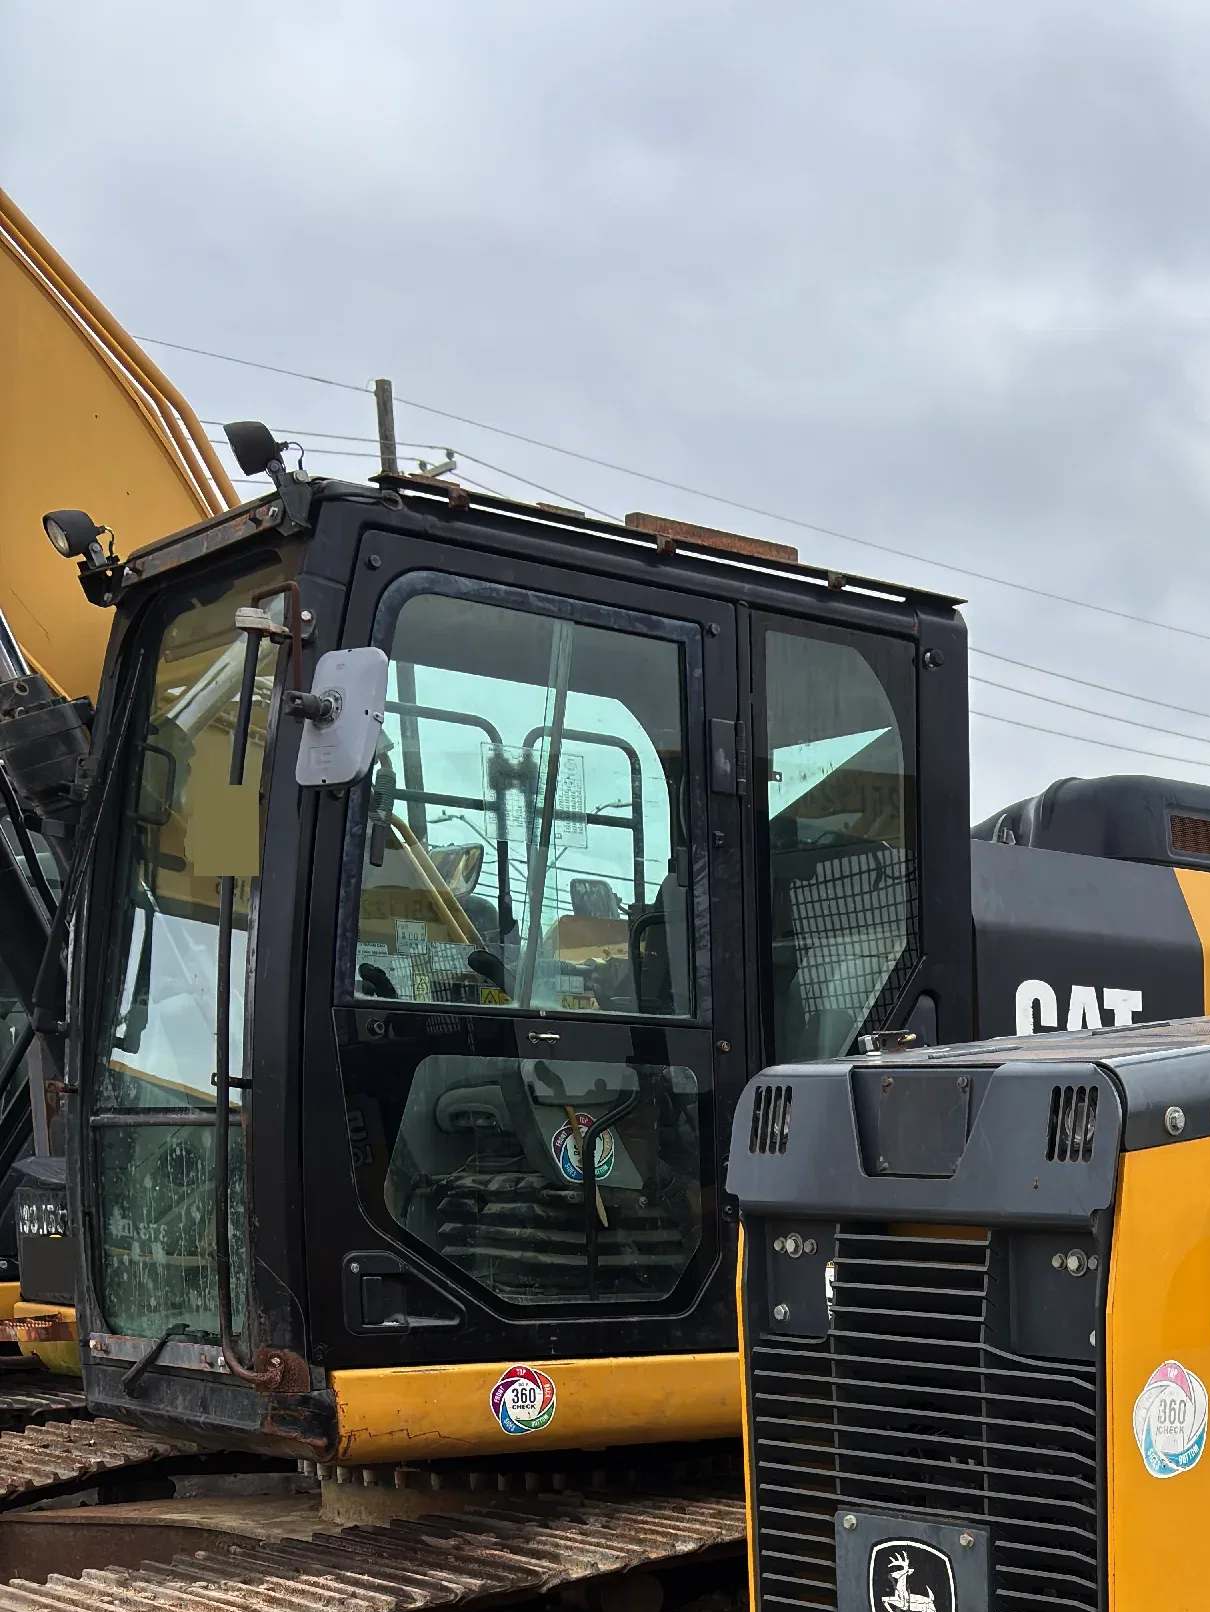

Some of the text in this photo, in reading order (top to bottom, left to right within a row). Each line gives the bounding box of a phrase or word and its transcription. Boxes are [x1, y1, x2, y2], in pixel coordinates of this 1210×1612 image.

[1015, 979, 1143, 1036] CAT
[1167, 1367, 1178, 1378] TOP
[511, 1387, 537, 1404] 360
[1158, 1398, 1187, 1425] 360
[1159, 1426, 1185, 1435] CHECK
[1178, 1444, 1200, 1464] BOTTOM
